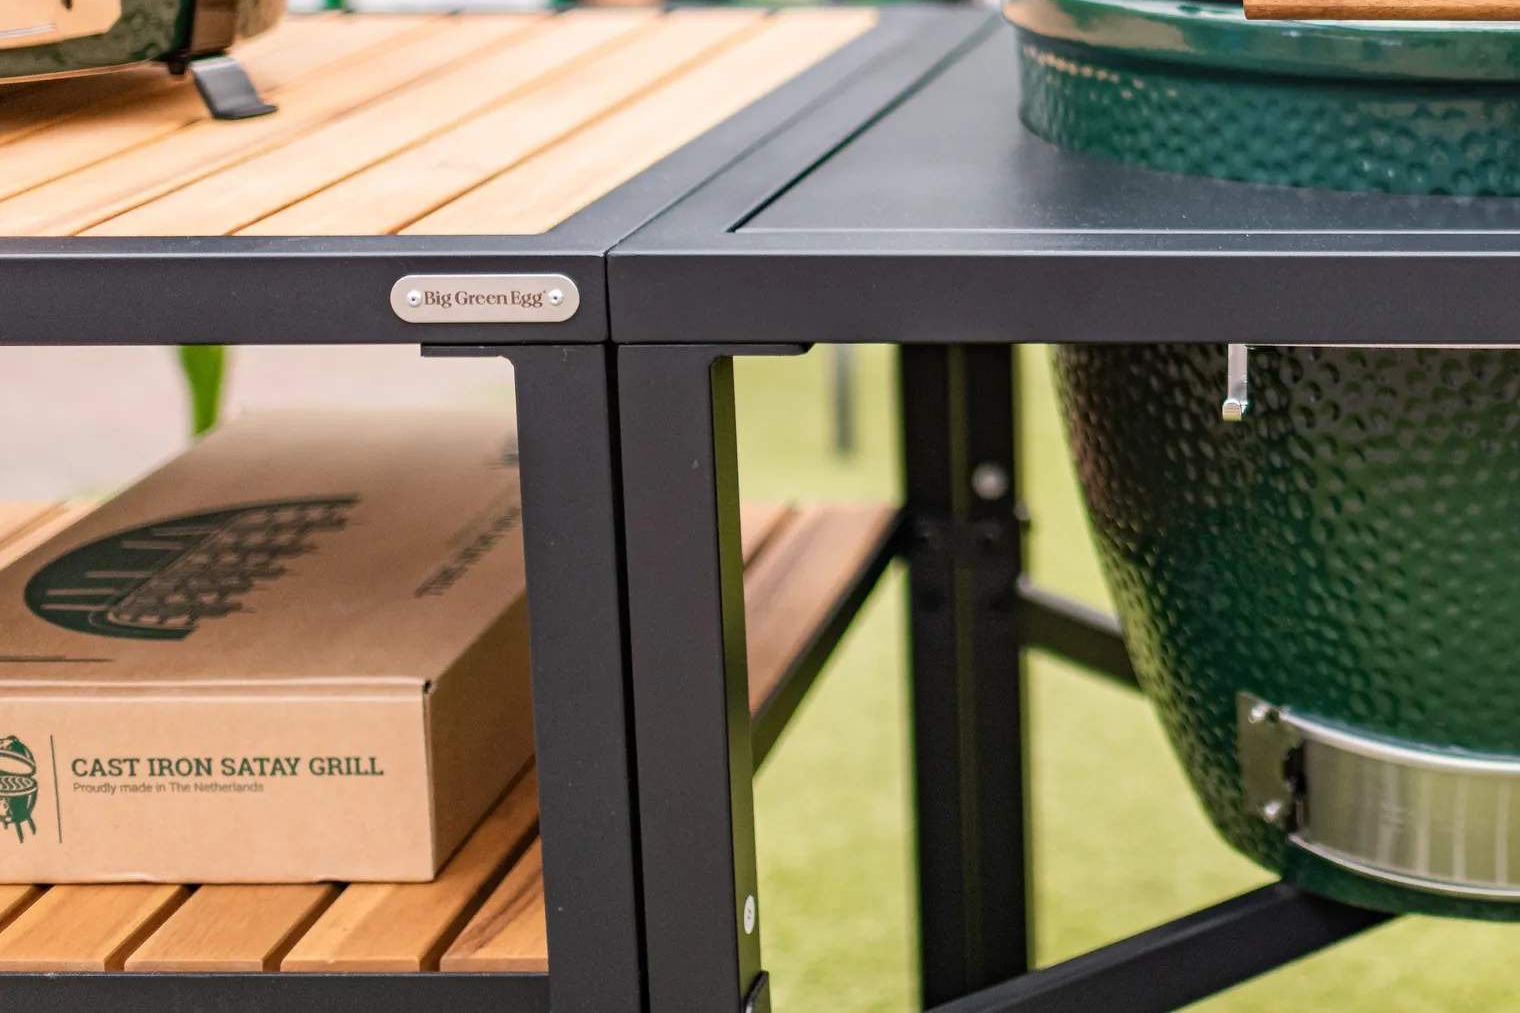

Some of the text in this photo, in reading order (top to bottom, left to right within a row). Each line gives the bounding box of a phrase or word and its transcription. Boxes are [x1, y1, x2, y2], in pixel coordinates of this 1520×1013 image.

[424, 290, 452, 308] Big
[455, 290, 508, 305] Green
[71, 757, 384, 777] CAST IRON SATAY GRILL
[73, 782, 264, 794] Proudly made in The Netherlands
